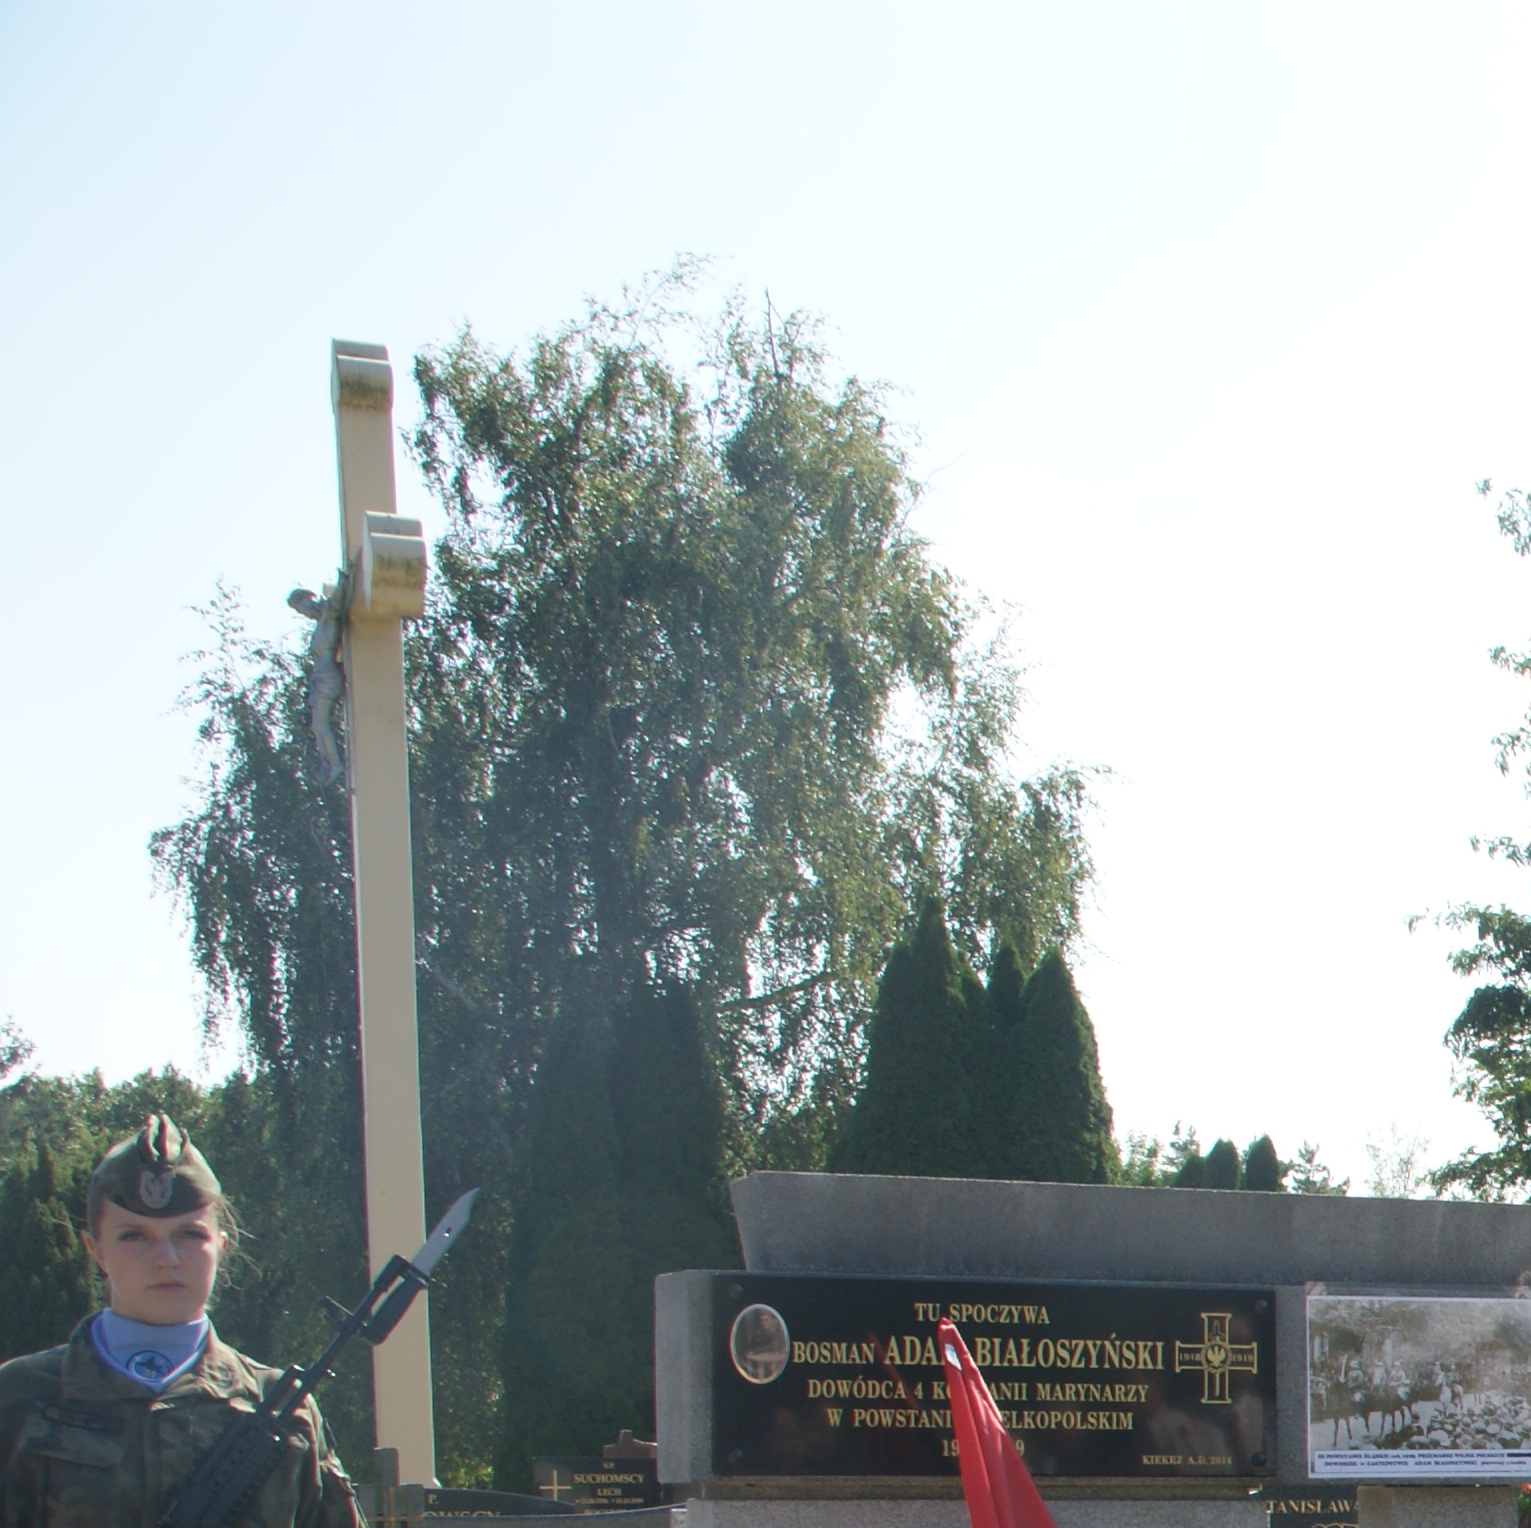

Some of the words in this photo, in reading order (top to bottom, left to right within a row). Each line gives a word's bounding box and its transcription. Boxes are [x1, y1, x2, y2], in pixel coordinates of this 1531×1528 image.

[914, 1303, 940, 1322] TU
[950, 1303, 1050, 1325] SPOCZYWA
[792, 1341, 875, 1364] BOSMAN
[884, 1336, 945, 1366] ADA
[975, 1332, 1164, 1370] BIAŁOSZYŃSKI
[807, 1376, 907, 1399] DOWÓDCA
[914, 1382, 923, 1400] 4
[932, 1381, 1027, 1400] KANII
[1037, 1383, 1149, 1402] MARYNARZY
[827, 1409, 843, 1427] W
[853, 1409, 952, 1428] POWSTANI
[1002, 1409, 1134, 1430] ELKOPOLSKIM
